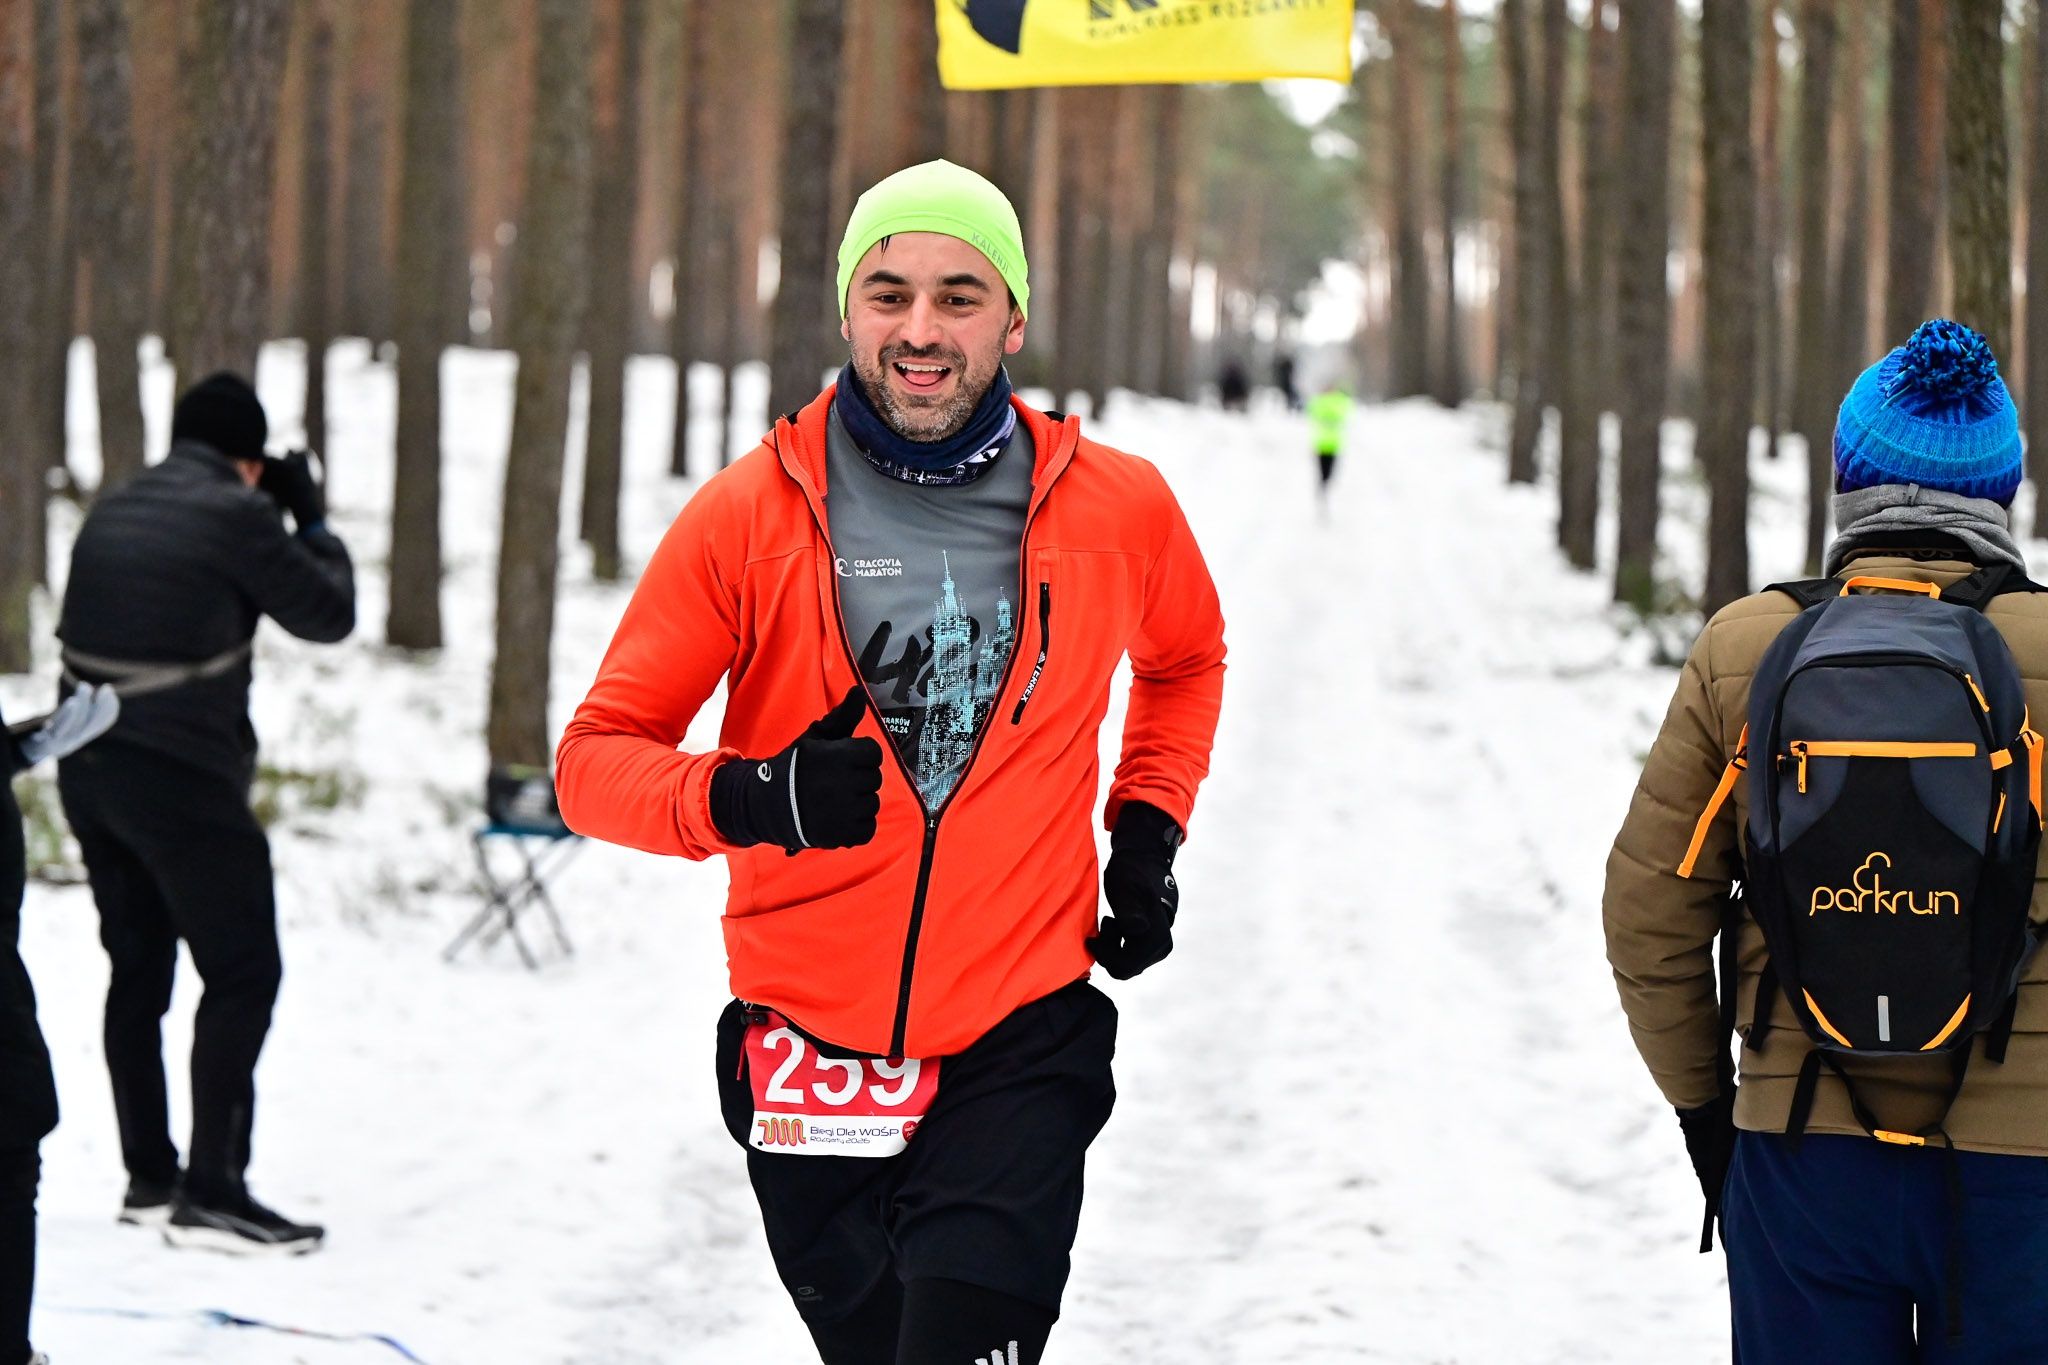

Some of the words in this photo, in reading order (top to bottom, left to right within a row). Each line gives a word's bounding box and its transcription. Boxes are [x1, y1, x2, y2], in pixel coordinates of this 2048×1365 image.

[971, 231, 1009, 274] KALENJI
[854, 557, 903, 569] CRACOVIA
[855, 566, 903, 577] MARATON
[1020, 665, 1042, 703] TERREX
[1808, 868, 1960, 917] parkrun
[762, 1026, 922, 1107] 259
[810, 1126, 834, 1137] Biegi
[836, 1128, 856, 1137] Dla
[858, 1126, 900, 1137] WOŚP
[845, 1137, 871, 1145] 2026
